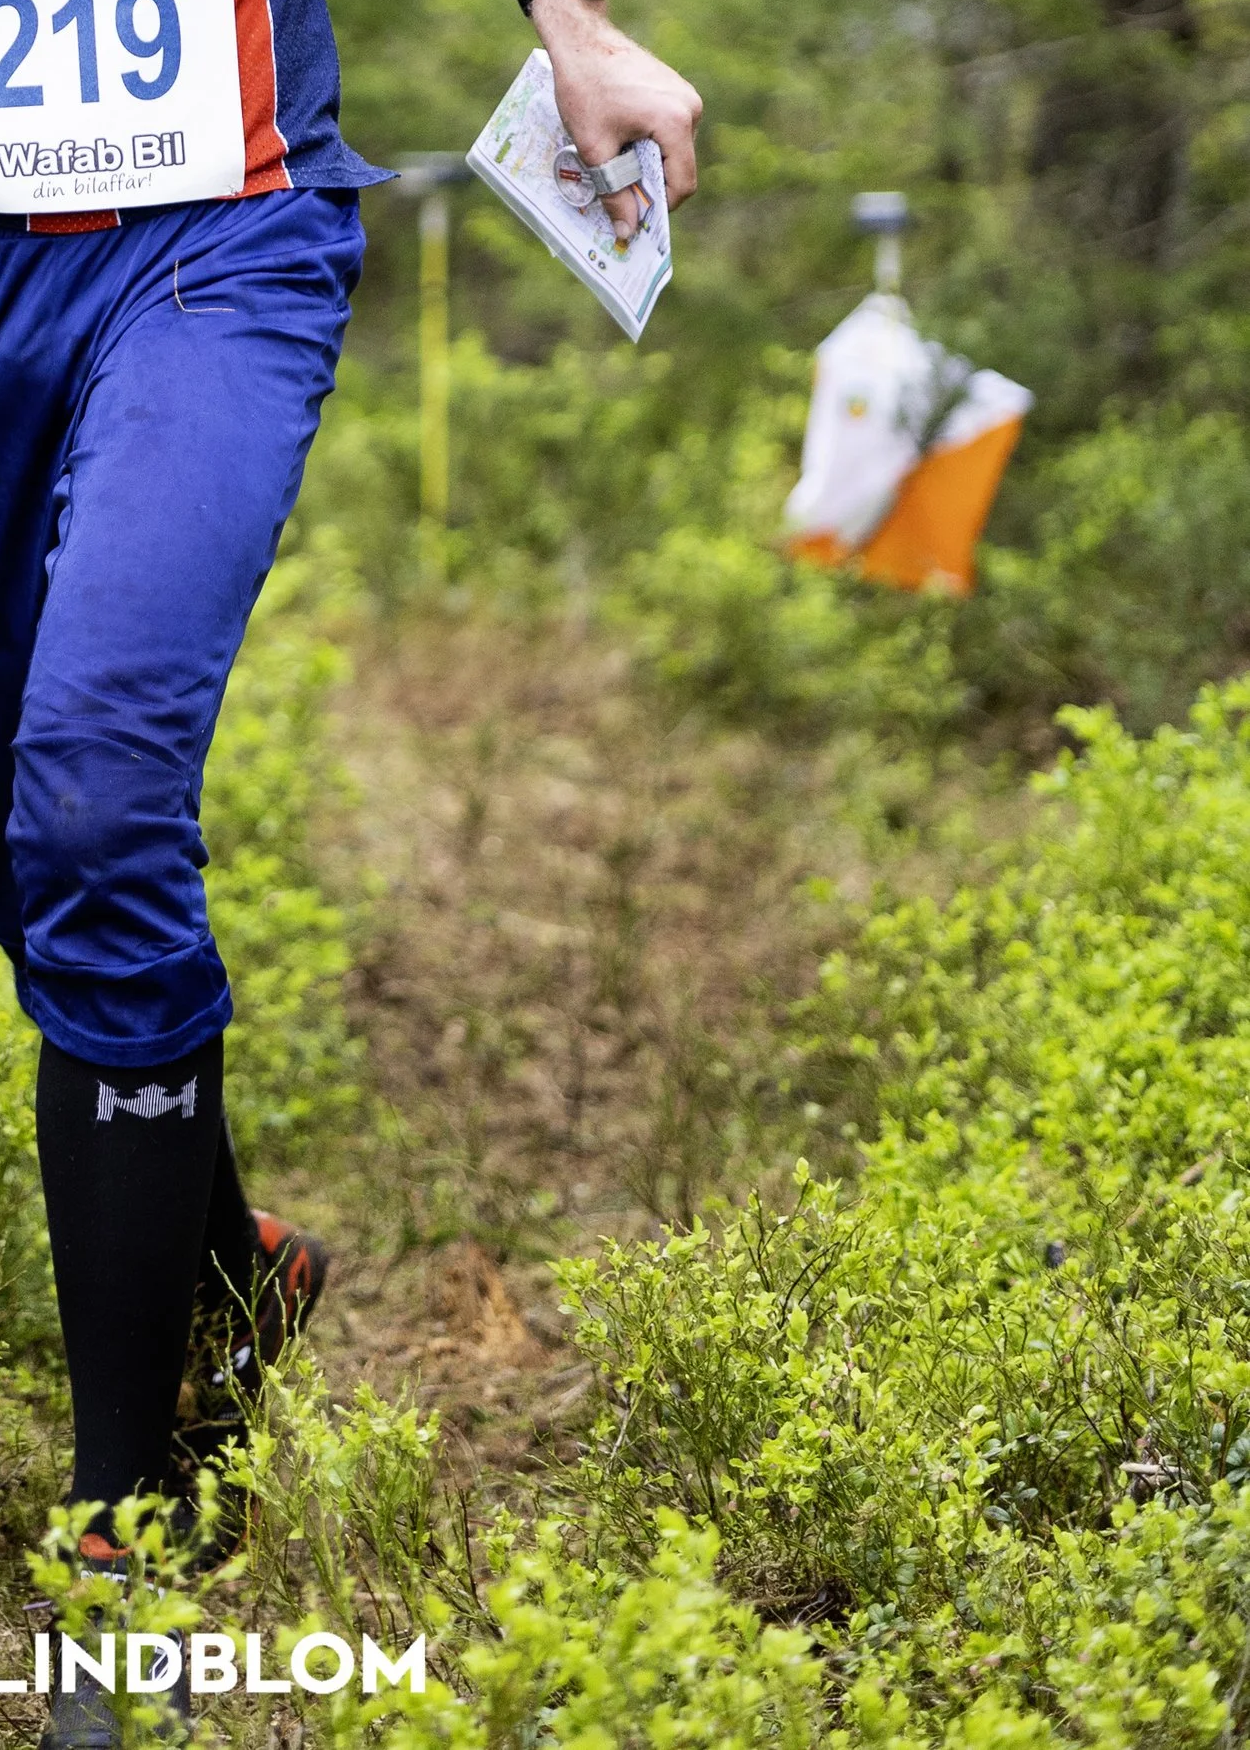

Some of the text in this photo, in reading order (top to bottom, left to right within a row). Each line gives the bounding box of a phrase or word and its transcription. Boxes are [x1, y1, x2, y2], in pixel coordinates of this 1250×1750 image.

[132, 131, 186, 169] Bil
[32, 172, 153, 199] din bilaffär!
